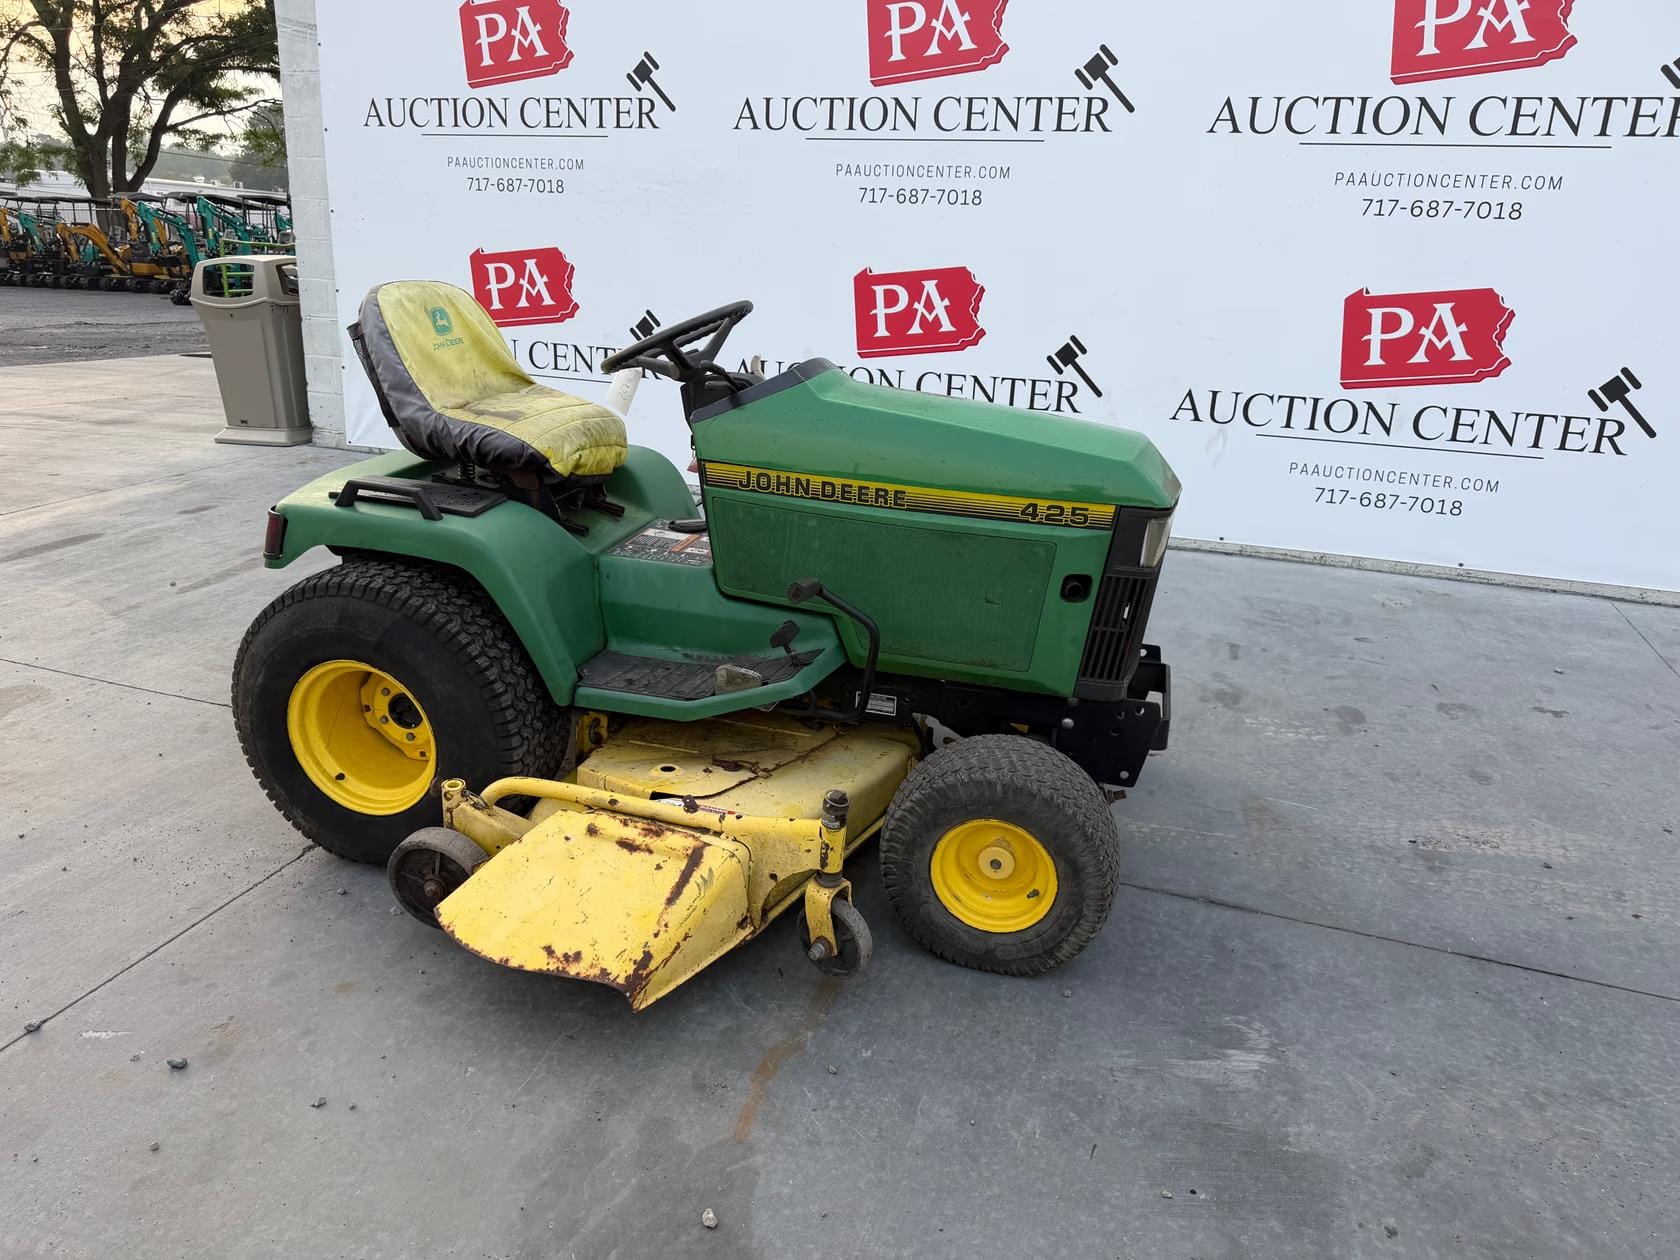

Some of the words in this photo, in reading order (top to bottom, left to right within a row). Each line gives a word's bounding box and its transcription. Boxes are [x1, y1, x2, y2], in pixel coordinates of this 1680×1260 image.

[474, 5, 550, 67] PA
[884, 0, 978, 62] PA
[1414, 0, 1536, 57] PA
[363, 97, 509, 128] AUCTION
[519, 97, 661, 129] CENTER
[733, 96, 922, 131] AUCTION
[933, 96, 1112, 133] CENTER
[1206, 95, 1456, 136] AUCTION
[447, 156, 584, 171] PAAUCTIONCENTER.COM
[836, 163, 1011, 180] PAAUCTIONCENTER.COM
[467, 177, 565, 194] 717-687-7018
[858, 187, 982, 206] 717-687-7018
[1334, 172, 1563, 191] PAAUCTIONCENTER.COM
[1362, 198, 1523, 221] 717-687-7018
[484, 258, 556, 310] PA
[870, 280, 957, 337] PA
[1361, 302, 1473, 366] PA
[1169, 388, 1400, 437] AUCTION
[1412, 405, 1628, 456] CENTER
[738, 470, 811, 497] JOHN
[820, 480, 907, 508] DEERE
[1288, 461, 1501, 493] PAAUCTIONCENTER.COM
[1019, 502, 1090, 526] 425
[1313, 486, 1464, 517] 717-687-7018
